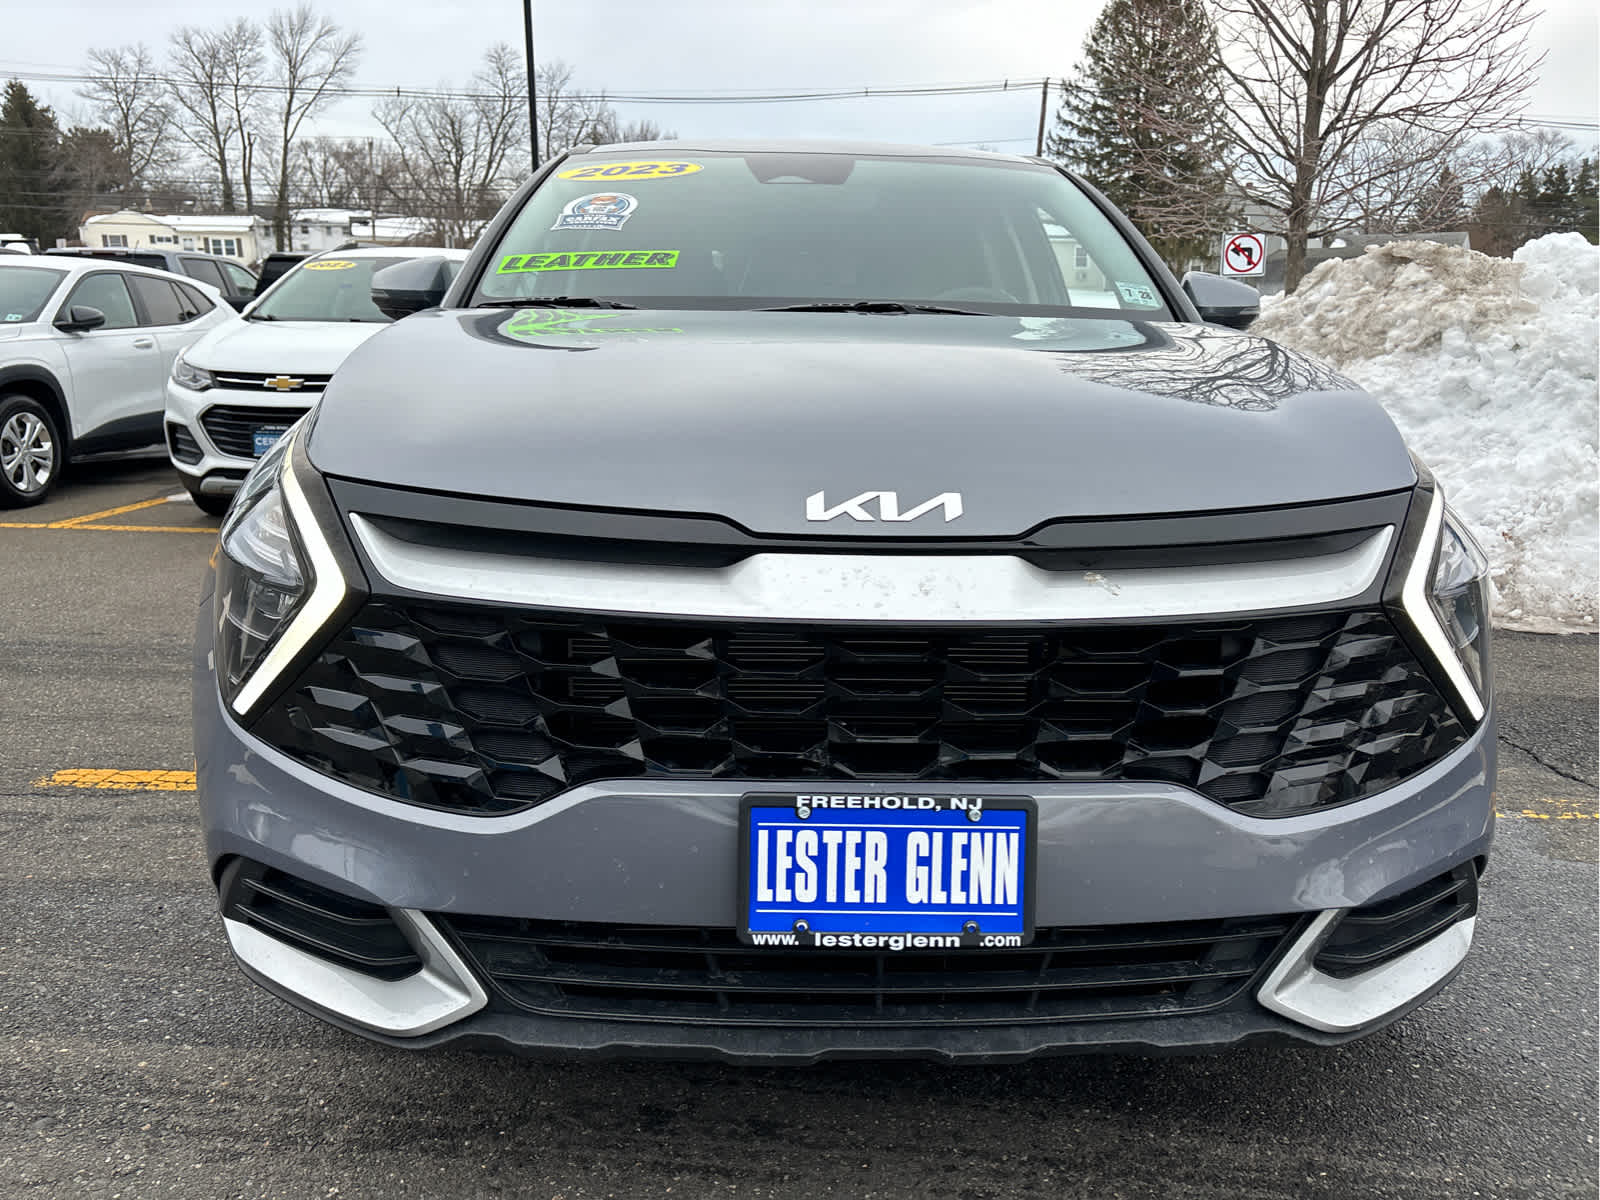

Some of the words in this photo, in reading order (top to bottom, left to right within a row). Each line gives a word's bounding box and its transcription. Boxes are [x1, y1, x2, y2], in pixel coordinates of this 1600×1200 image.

[569, 164, 689, 179] 2023
[501, 251, 676, 271] LEATHER
[806, 490, 963, 523] KIA
[796, 795, 942, 811] FREEHOLD,
[950, 798, 983, 811] NJ
[757, 829, 888, 904] LESTER
[905, 831, 1019, 905] GLENN
